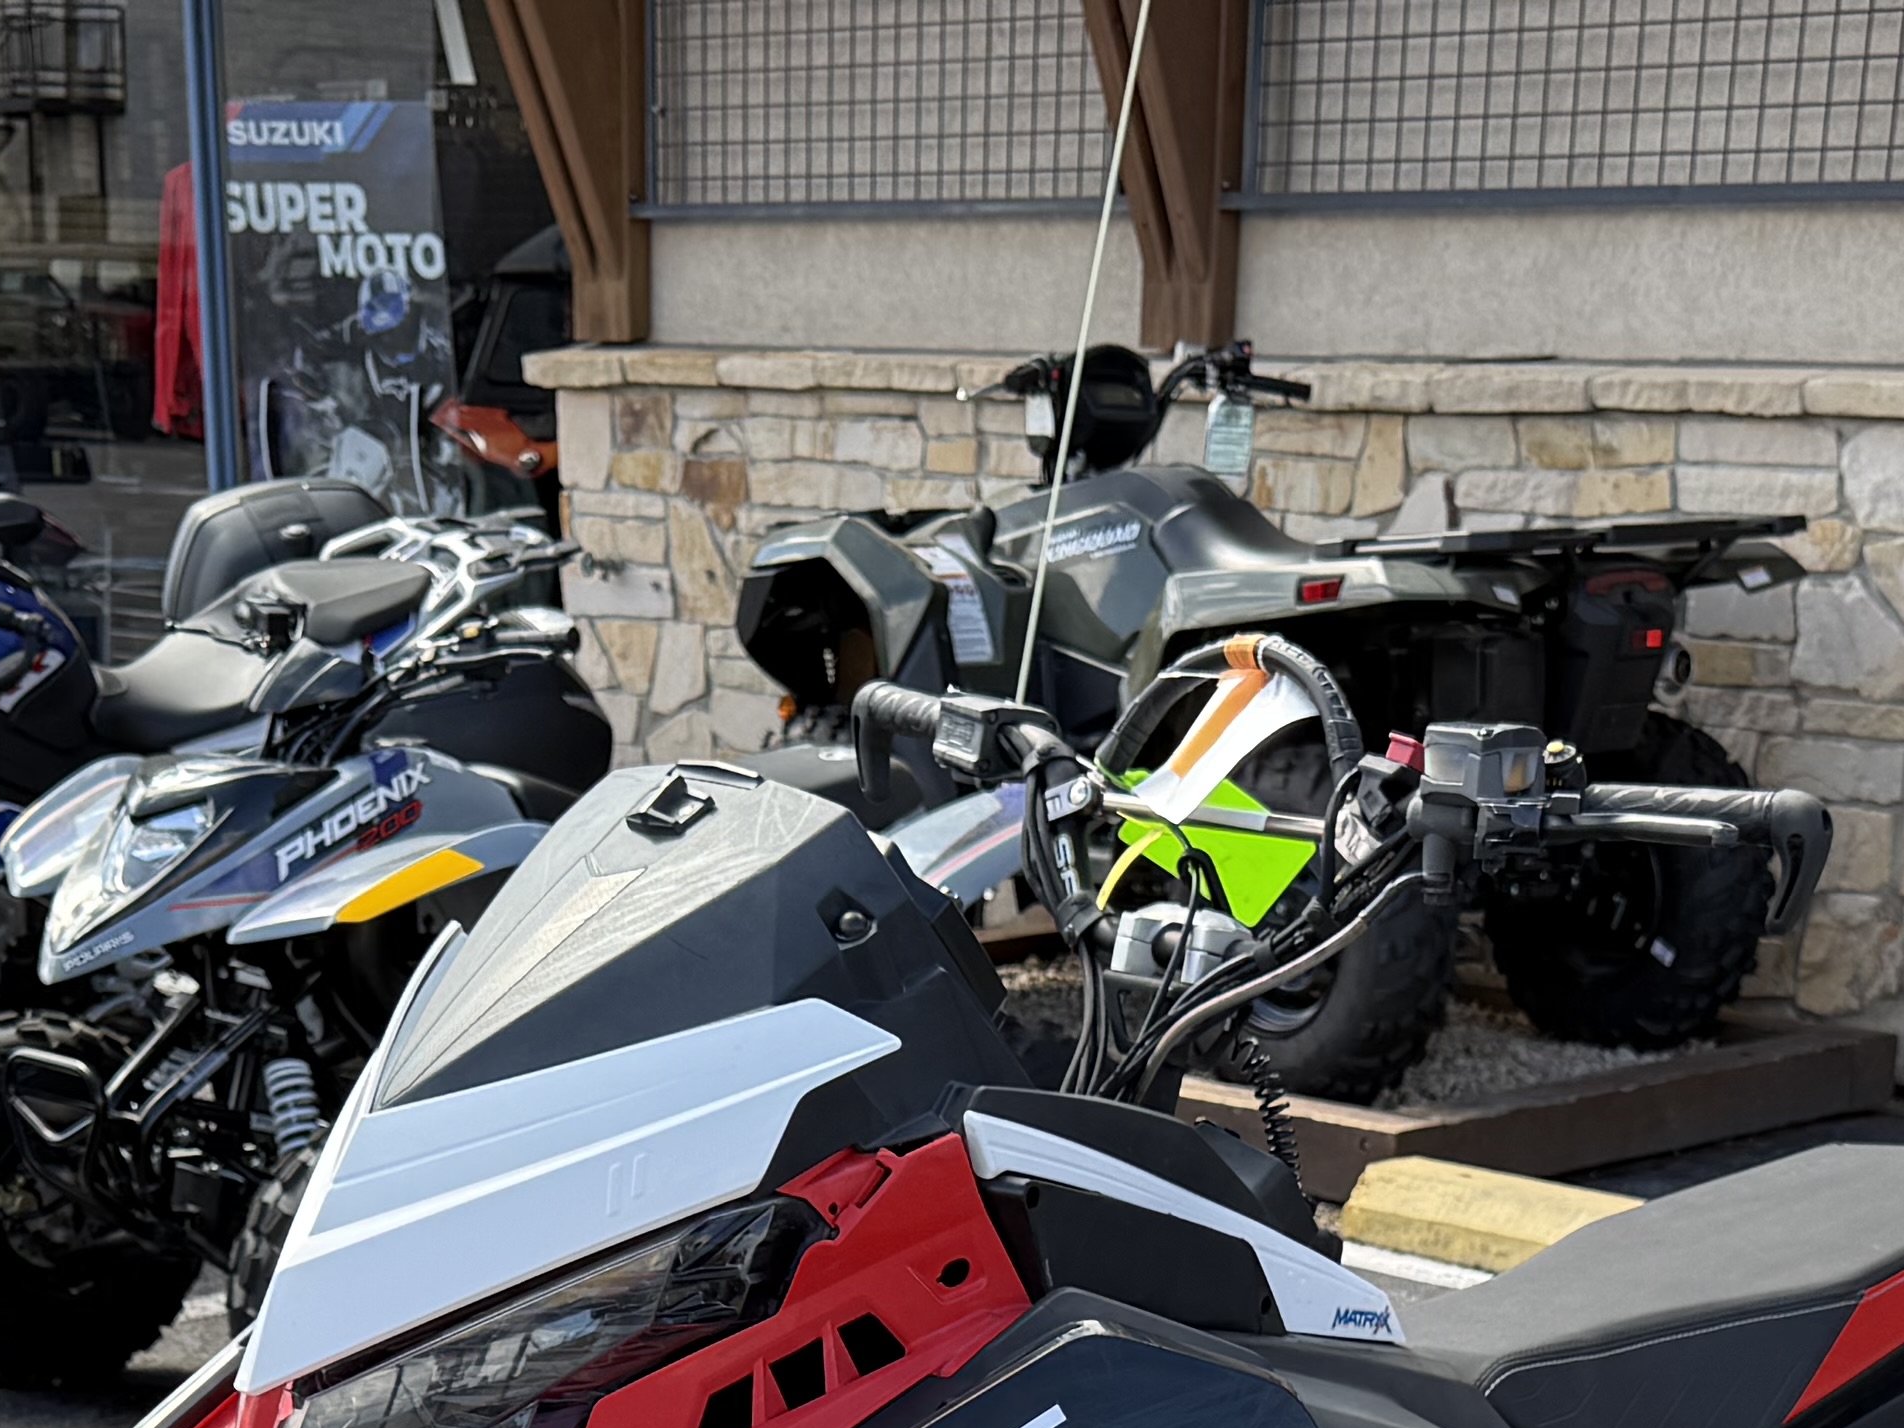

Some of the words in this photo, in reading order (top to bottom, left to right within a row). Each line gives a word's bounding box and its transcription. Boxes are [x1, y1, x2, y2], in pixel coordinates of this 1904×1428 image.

[226, 119, 346, 146] SUZUKI
[225, 180, 369, 234] SUPER
[316, 231, 447, 281] MOTO
[274, 762, 433, 882] PHOENIX
[356, 800, 424, 853] 200
[1330, 1305, 1393, 1336] MATRYX
